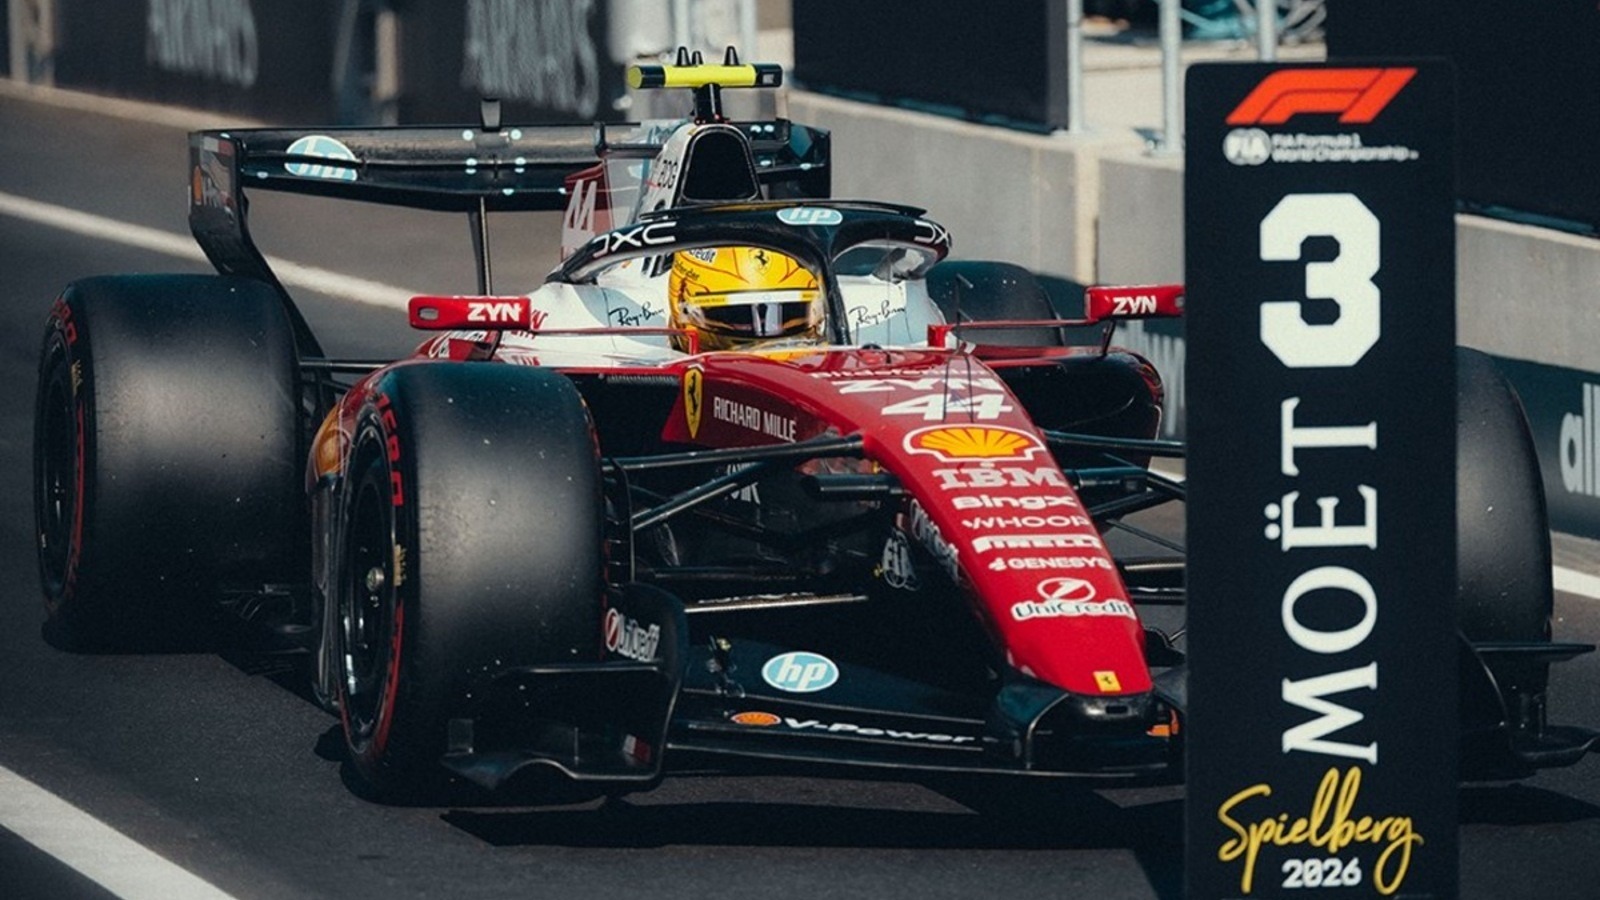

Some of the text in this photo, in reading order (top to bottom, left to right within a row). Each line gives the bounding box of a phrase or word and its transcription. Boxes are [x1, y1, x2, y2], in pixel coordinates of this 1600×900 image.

[1259, 193, 1381, 368] 3
[467, 303, 521, 322] ZYN
[1112, 295, 1157, 315] ZYN
[831, 377, 1006, 395] ZYN
[713, 396, 797, 443] RICHARD MILLE
[881, 393, 1013, 421] 44
[931, 467, 1069, 490] IBM
[961, 515, 1090, 530] WHOOP
[1007, 556, 1112, 571] GENESYS
[1264, 397, 1378, 765] MOËT
[1012, 599, 1135, 620] UniCredit
[774, 652, 828, 690] hp
[784, 717, 975, 743] V-Power
[1217, 765, 1425, 896] Spielberg
[1281, 857, 1363, 888] 2026
